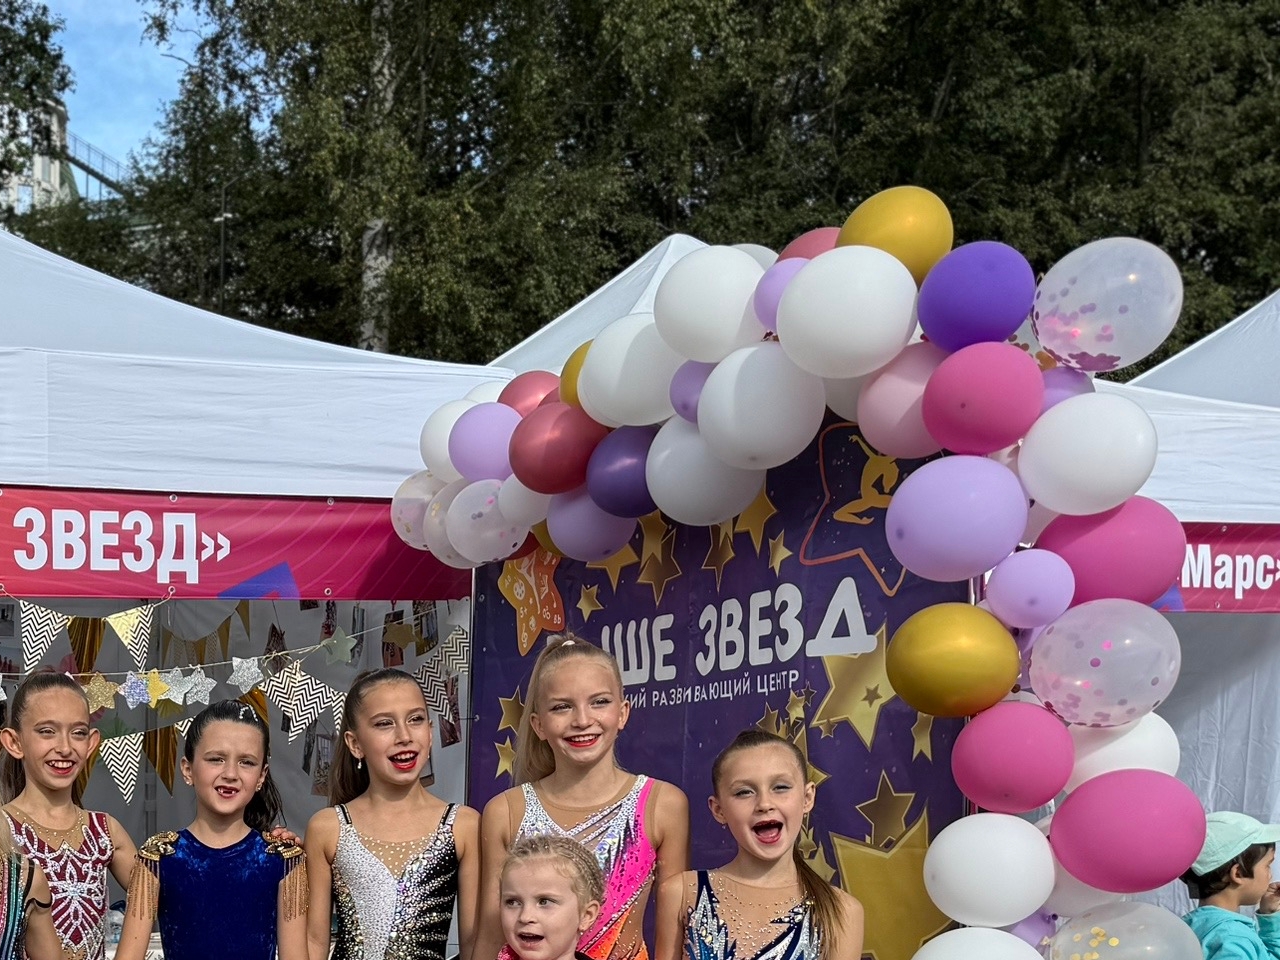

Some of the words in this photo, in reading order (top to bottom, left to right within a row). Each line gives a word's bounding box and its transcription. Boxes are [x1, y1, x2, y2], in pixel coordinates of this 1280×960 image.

[13, 508, 231, 584] ЗВЕЗД»
[1181, 544, 1280, 600] Марс
[695, 576, 878, 676] ЗВЕЗД
[652, 672, 751, 707] РАЗВИВАЮЩИЙ
[757, 669, 800, 697] ЦЕНТР
